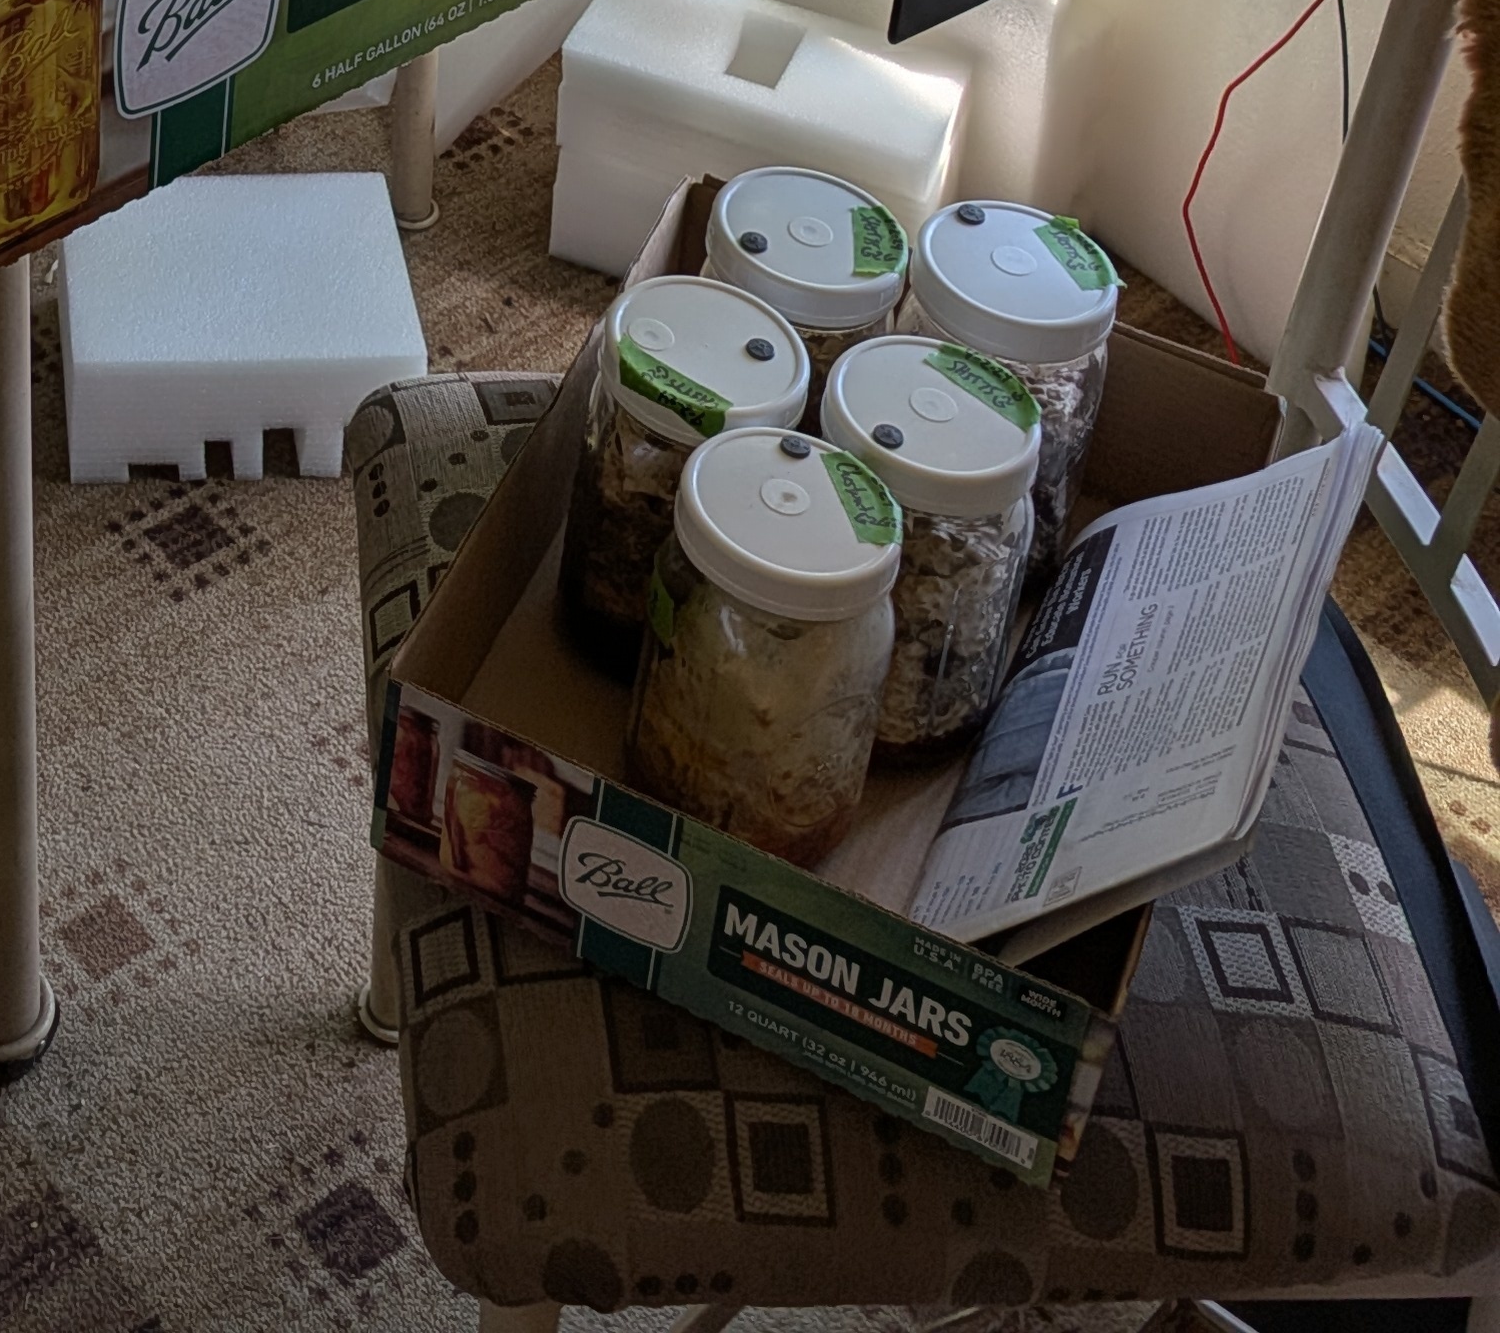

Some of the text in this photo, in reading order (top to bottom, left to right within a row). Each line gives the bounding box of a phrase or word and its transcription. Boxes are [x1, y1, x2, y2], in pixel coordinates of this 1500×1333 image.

[311, 74, 322, 89] 6
[324, 51, 364, 84] HALF
[365, 22, 422, 62] GALLON
[423, 13, 445, 34] (64
[446, 4, 467, 22] OZ
[1065, 567, 1092, 615] Workers
[1096, 643, 1128, 696] RUN FOR
[1115, 602, 1159, 692] SOMETHING
[575, 851, 675, 909] Ball
[723, 902, 973, 1047] MASON JARS
[913, 944, 959, 974] U.S.A.
[914, 936, 962, 963] MADE IN
[973, 963, 1003, 984] BPA
[758, 960, 920, 1046] SEALS UP TO 18 MONTHS
[971, 972, 1003, 994] FREE
[1020, 993, 1062, 1018] MOUTH
[1028, 989, 1057, 1008] WIDE
[727, 1000, 744, 1016] 12
[746, 1010, 801, 1043] QUART
[801, 1036, 826, 1054] (32
[859, 1064, 889, 1089] 946
[890, 1080, 918, 1102] ml)
